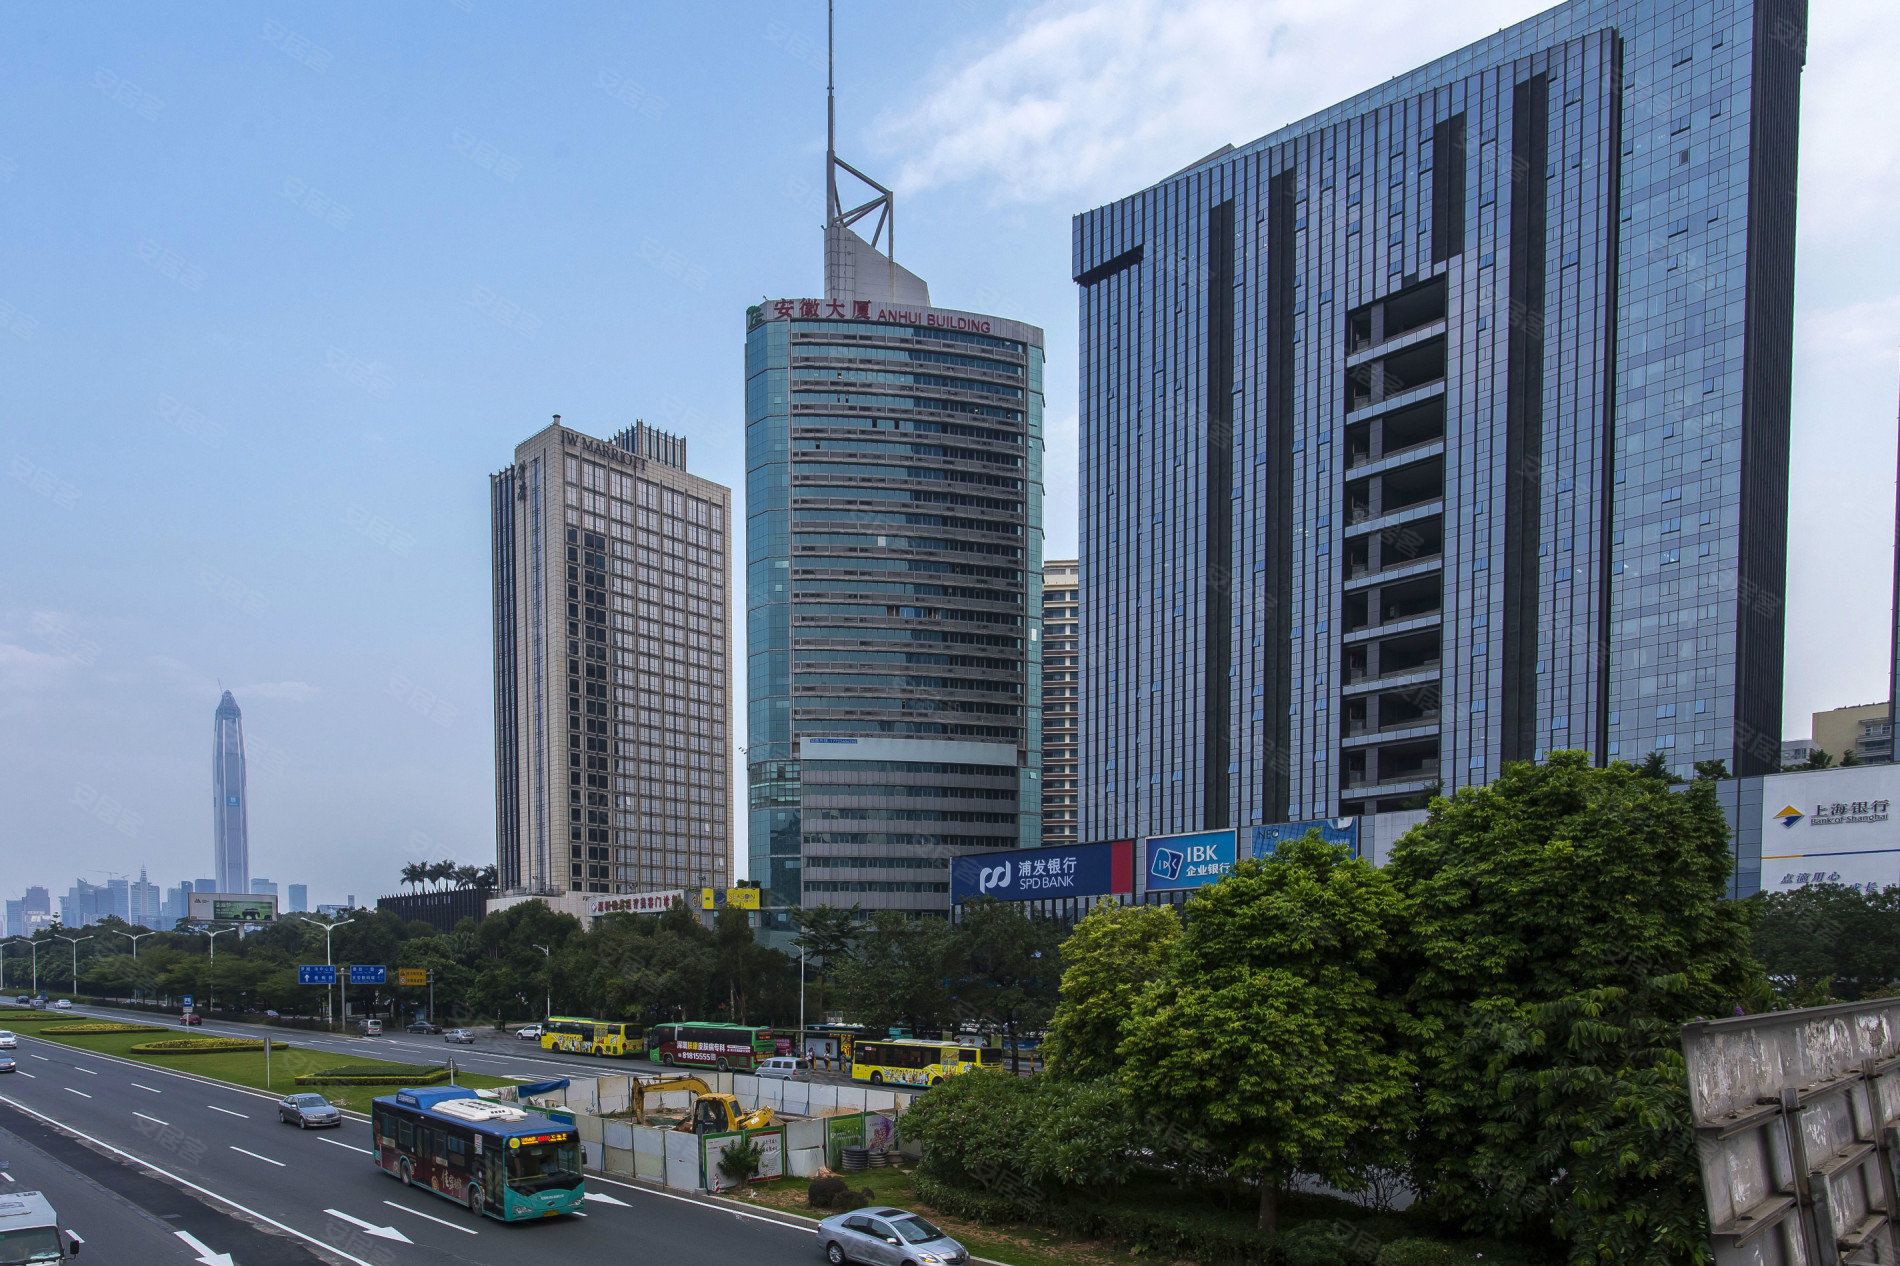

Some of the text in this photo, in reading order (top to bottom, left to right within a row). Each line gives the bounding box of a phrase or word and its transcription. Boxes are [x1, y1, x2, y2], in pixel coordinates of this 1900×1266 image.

[774, 298, 871, 320] 安徽大厦
[878, 309, 991, 334] ANHUI BUILDING
[582, 436, 648, 472] MARRIOTT
[1810, 799, 1890, 818] 上海银行
[1810, 813, 1889, 826] Bank of Shanghai
[1258, 828, 1280, 840] NEO
[1187, 844, 1219, 863] IBK
[1018, 857, 1078, 877] 浦发银行
[1186, 862, 1232, 877] 企业银行
[1019, 874, 1075, 890] SPD BANK
